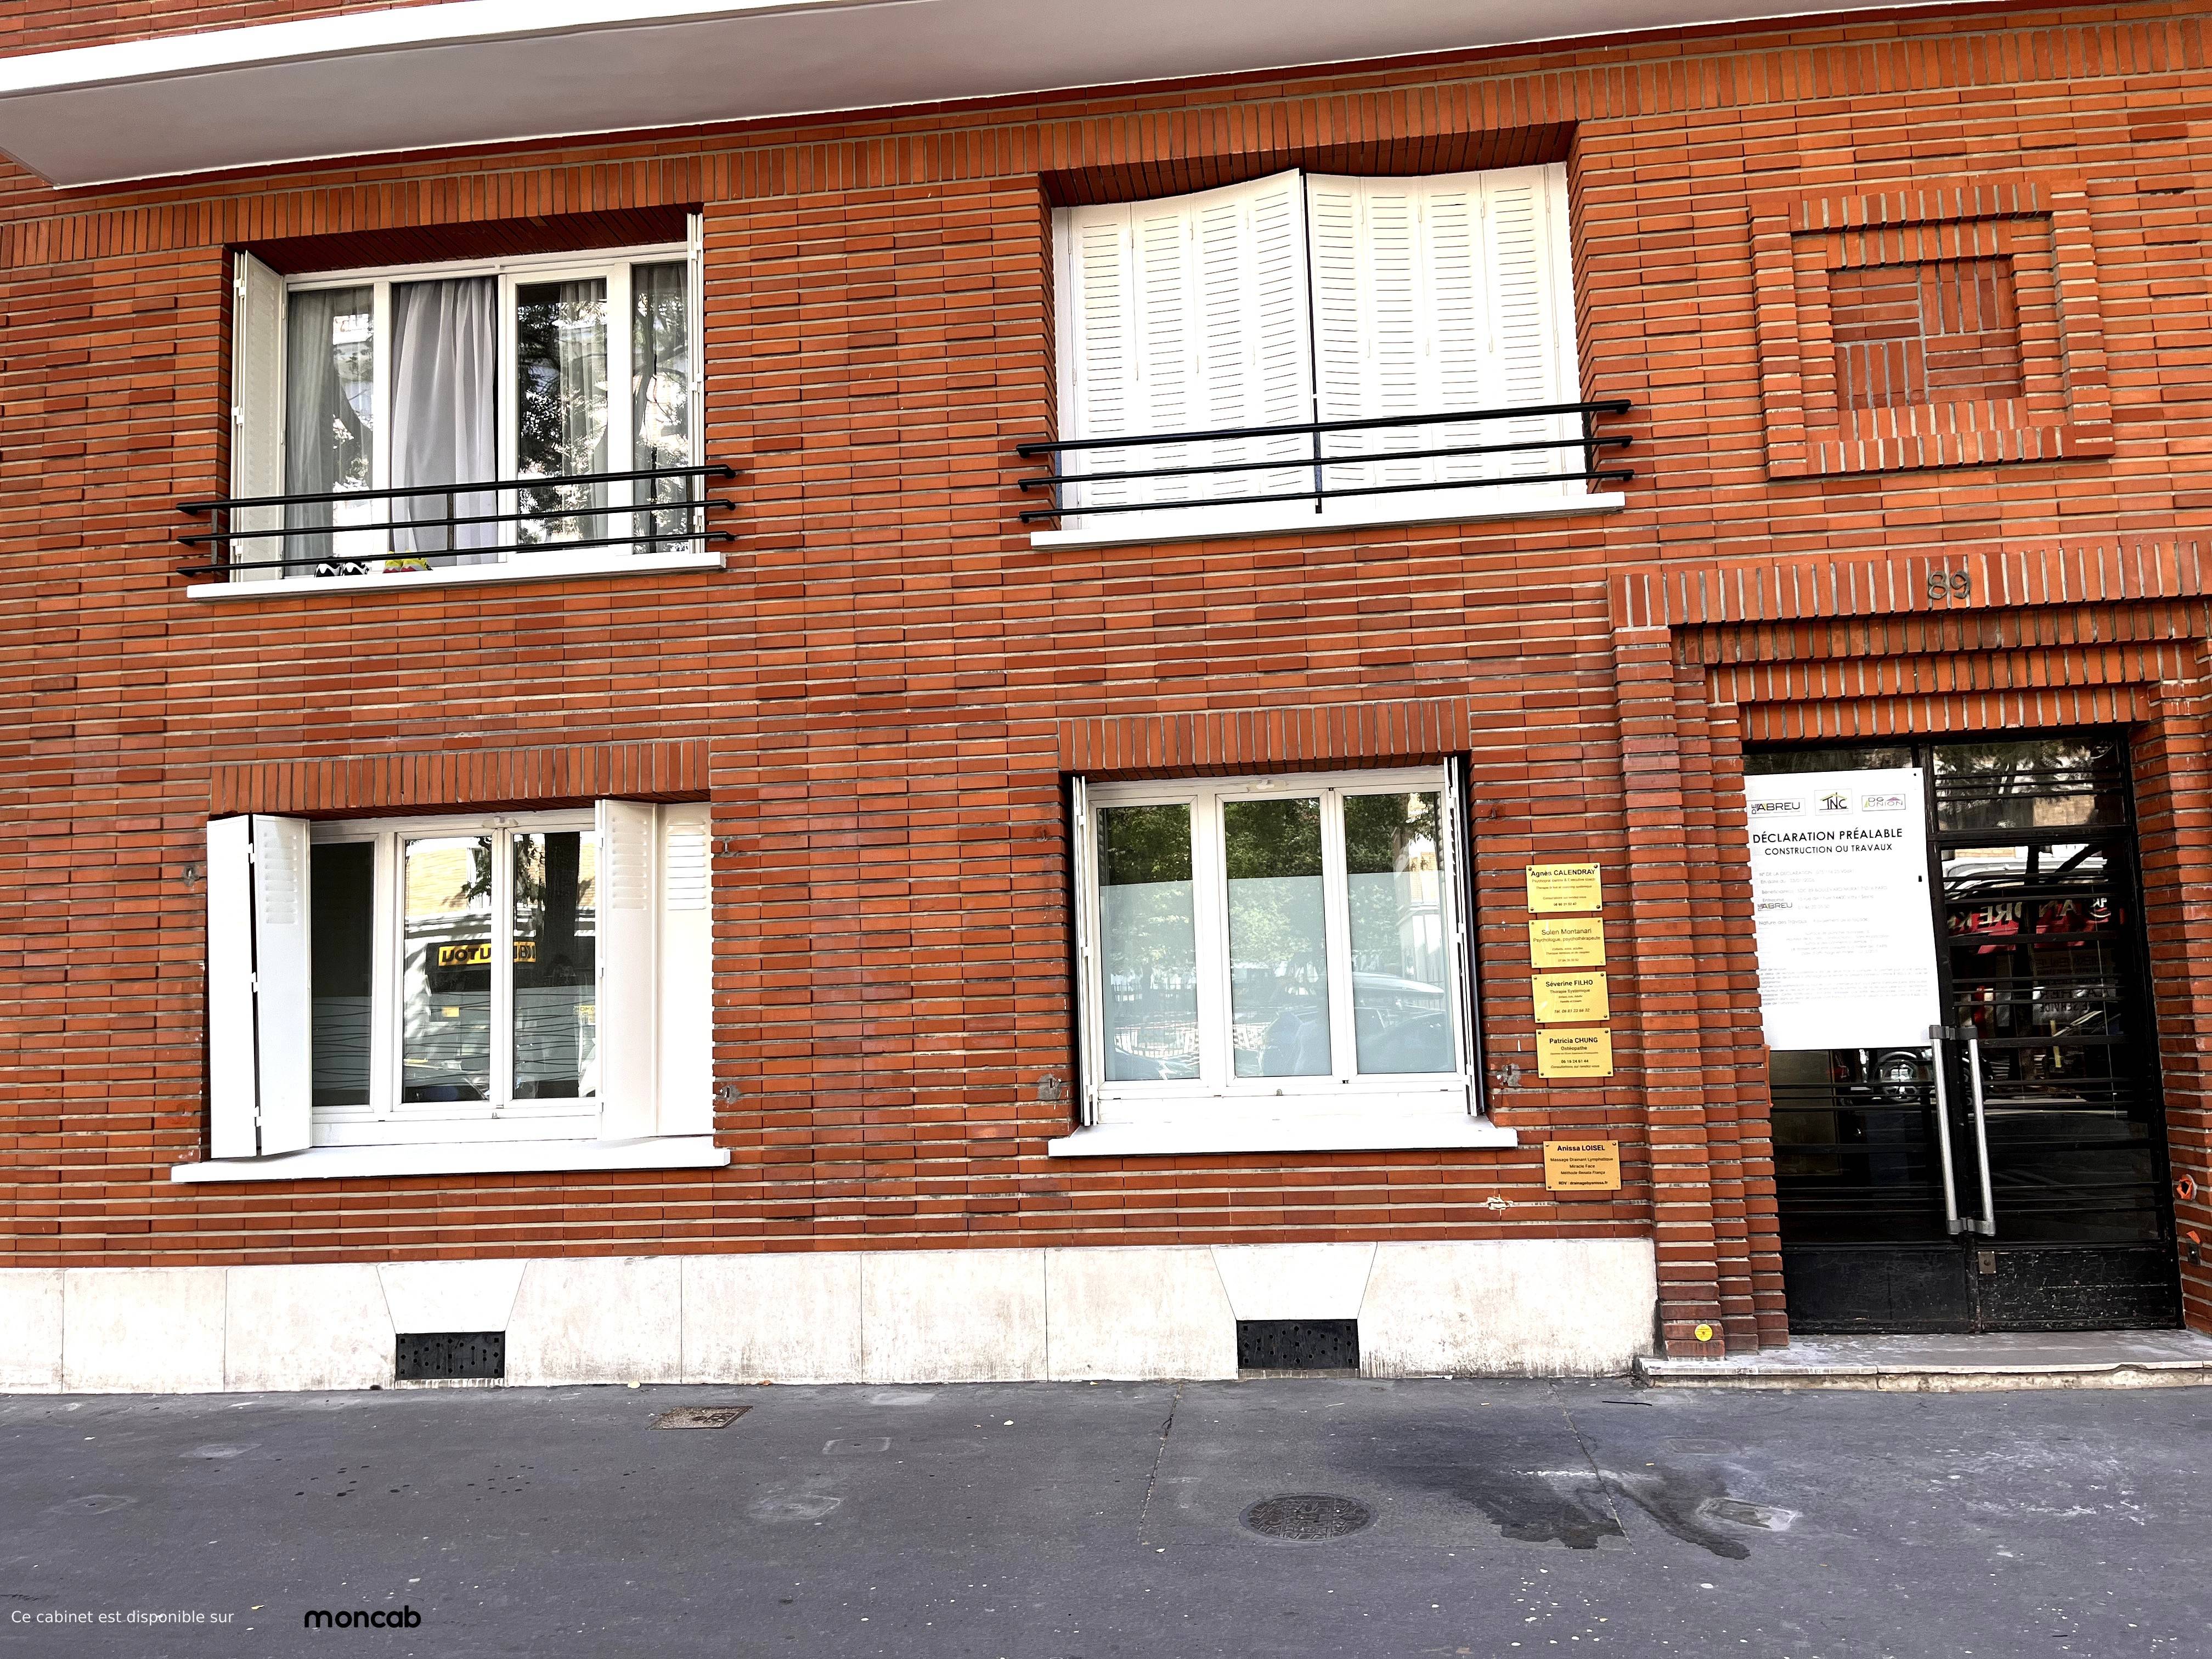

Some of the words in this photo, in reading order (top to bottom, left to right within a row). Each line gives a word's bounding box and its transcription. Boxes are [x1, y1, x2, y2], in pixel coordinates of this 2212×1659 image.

[1928, 570, 1971, 599] 89
[1757, 802, 1801, 811] ABREU
[1753, 831, 1835, 843] DÉCLARATION
[1839, 827, 1903, 840] PRÉALABLE
[1765, 847, 1832, 855] CONSTRUCTION
[1852, 843, 1893, 851] TRAVAUX
